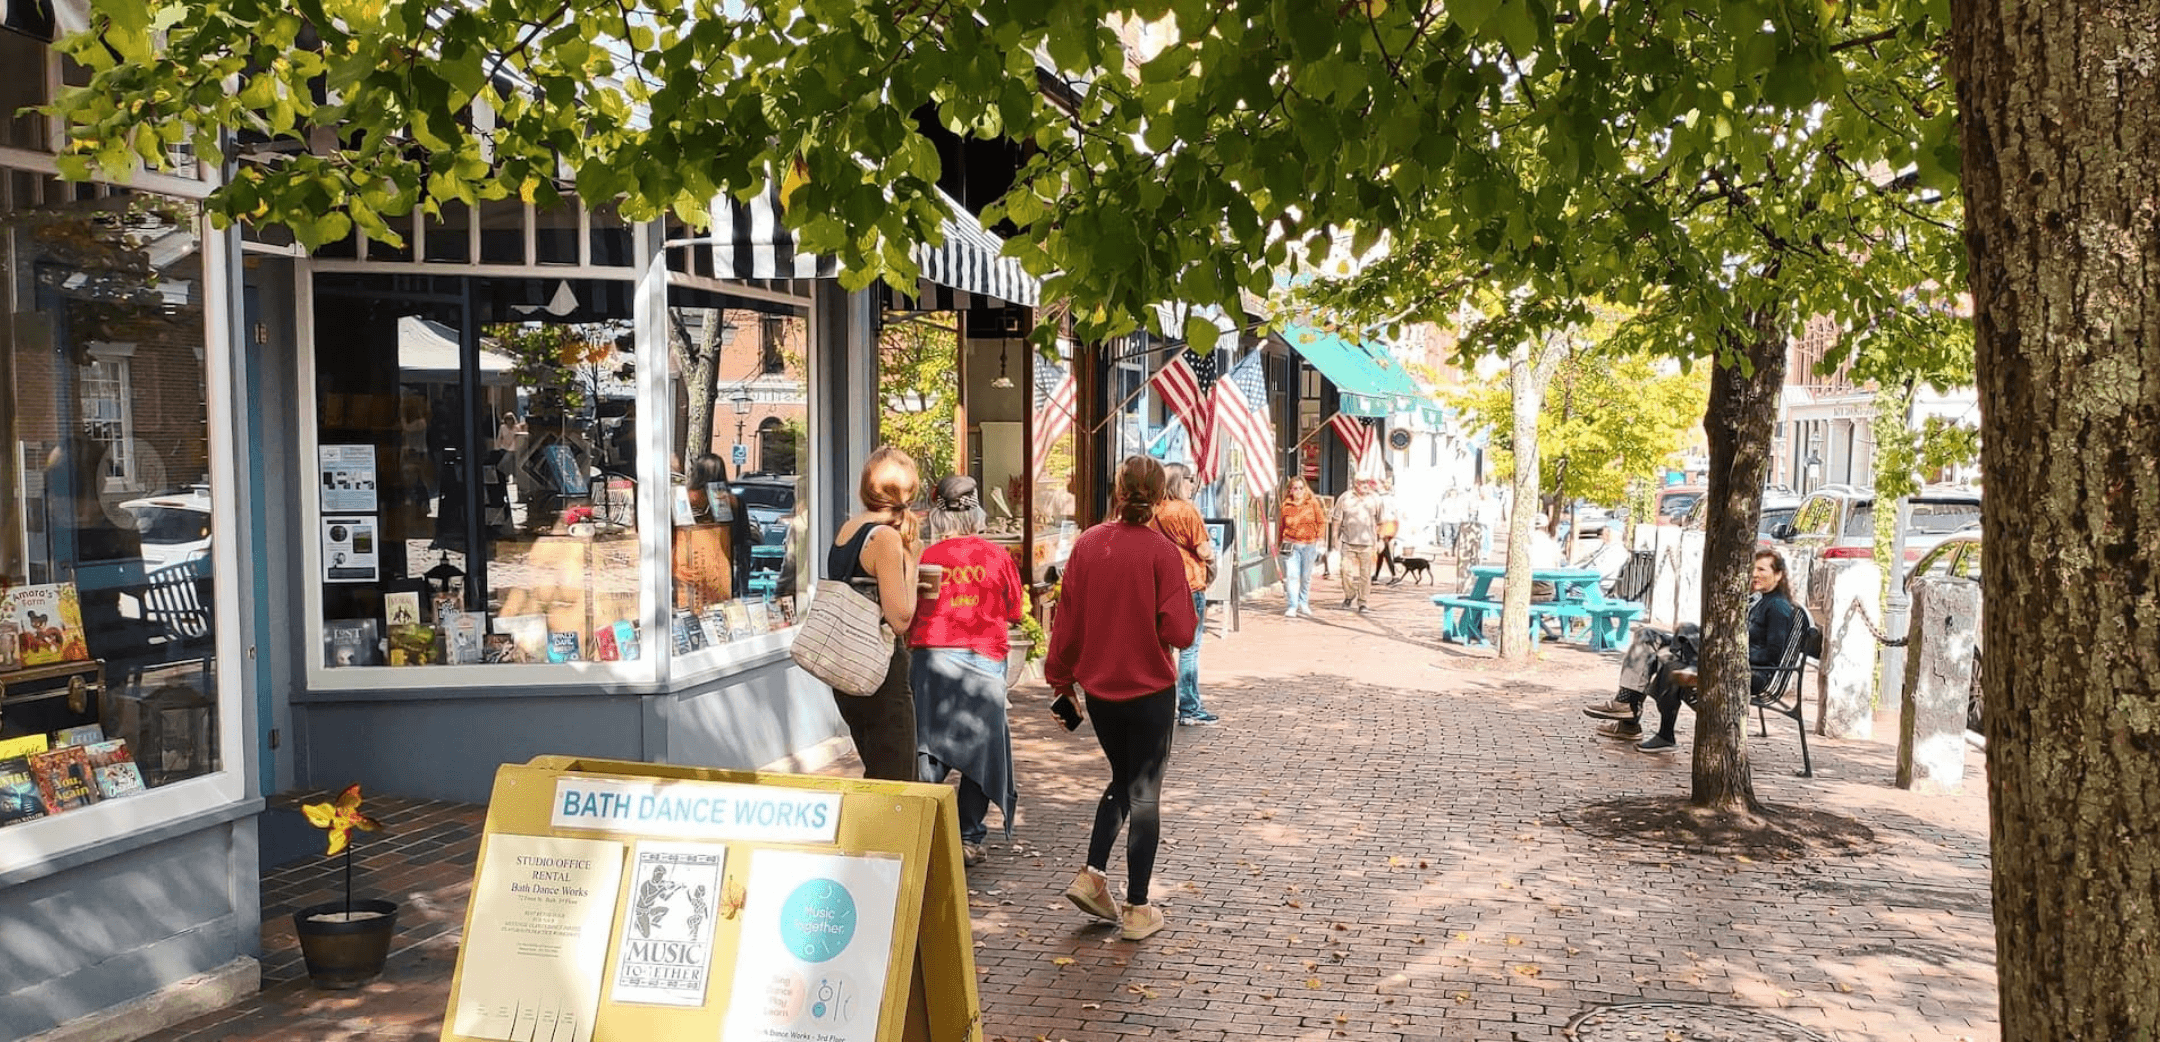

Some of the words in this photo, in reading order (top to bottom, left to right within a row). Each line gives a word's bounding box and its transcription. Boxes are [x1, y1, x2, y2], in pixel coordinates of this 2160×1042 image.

[13, 589, 53, 601] Amara's
[562, 790, 632, 819] BATH
[637, 795, 727, 824] DANCE
[734, 801, 829, 829] WORKS
[532, 870, 571, 882] RENTAL
[511, 882, 531, 893] Bath
[532, 883, 560, 895] Dance
[562, 886, 589, 897] Works
[627, 941, 701, 964] MUSIC
[790, 1031, 810, 1041] Works
